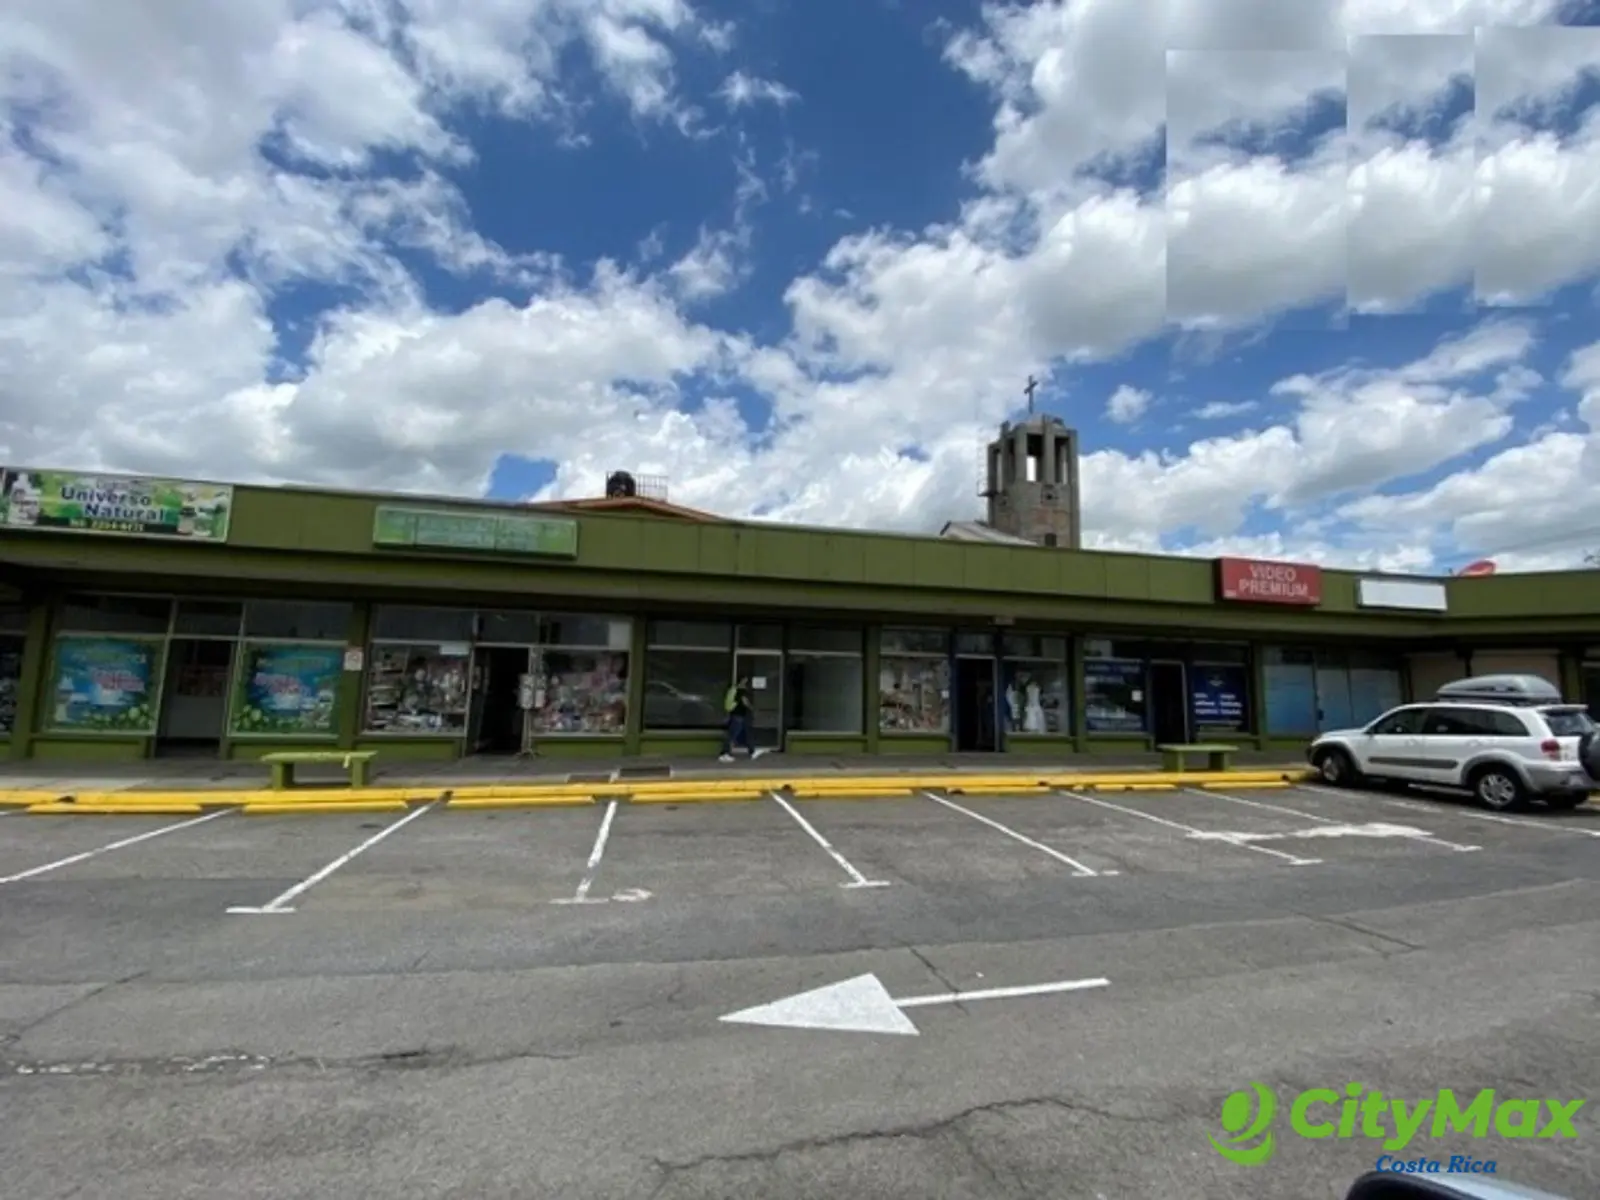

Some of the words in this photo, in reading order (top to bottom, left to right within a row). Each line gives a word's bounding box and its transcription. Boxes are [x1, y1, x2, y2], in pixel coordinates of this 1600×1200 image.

[61, 486, 152, 506] Universo
[84, 503, 164, 521] Natural
[1249, 562, 1297, 582] VIDEO
[1238, 578, 1308, 596] PREMIUM
